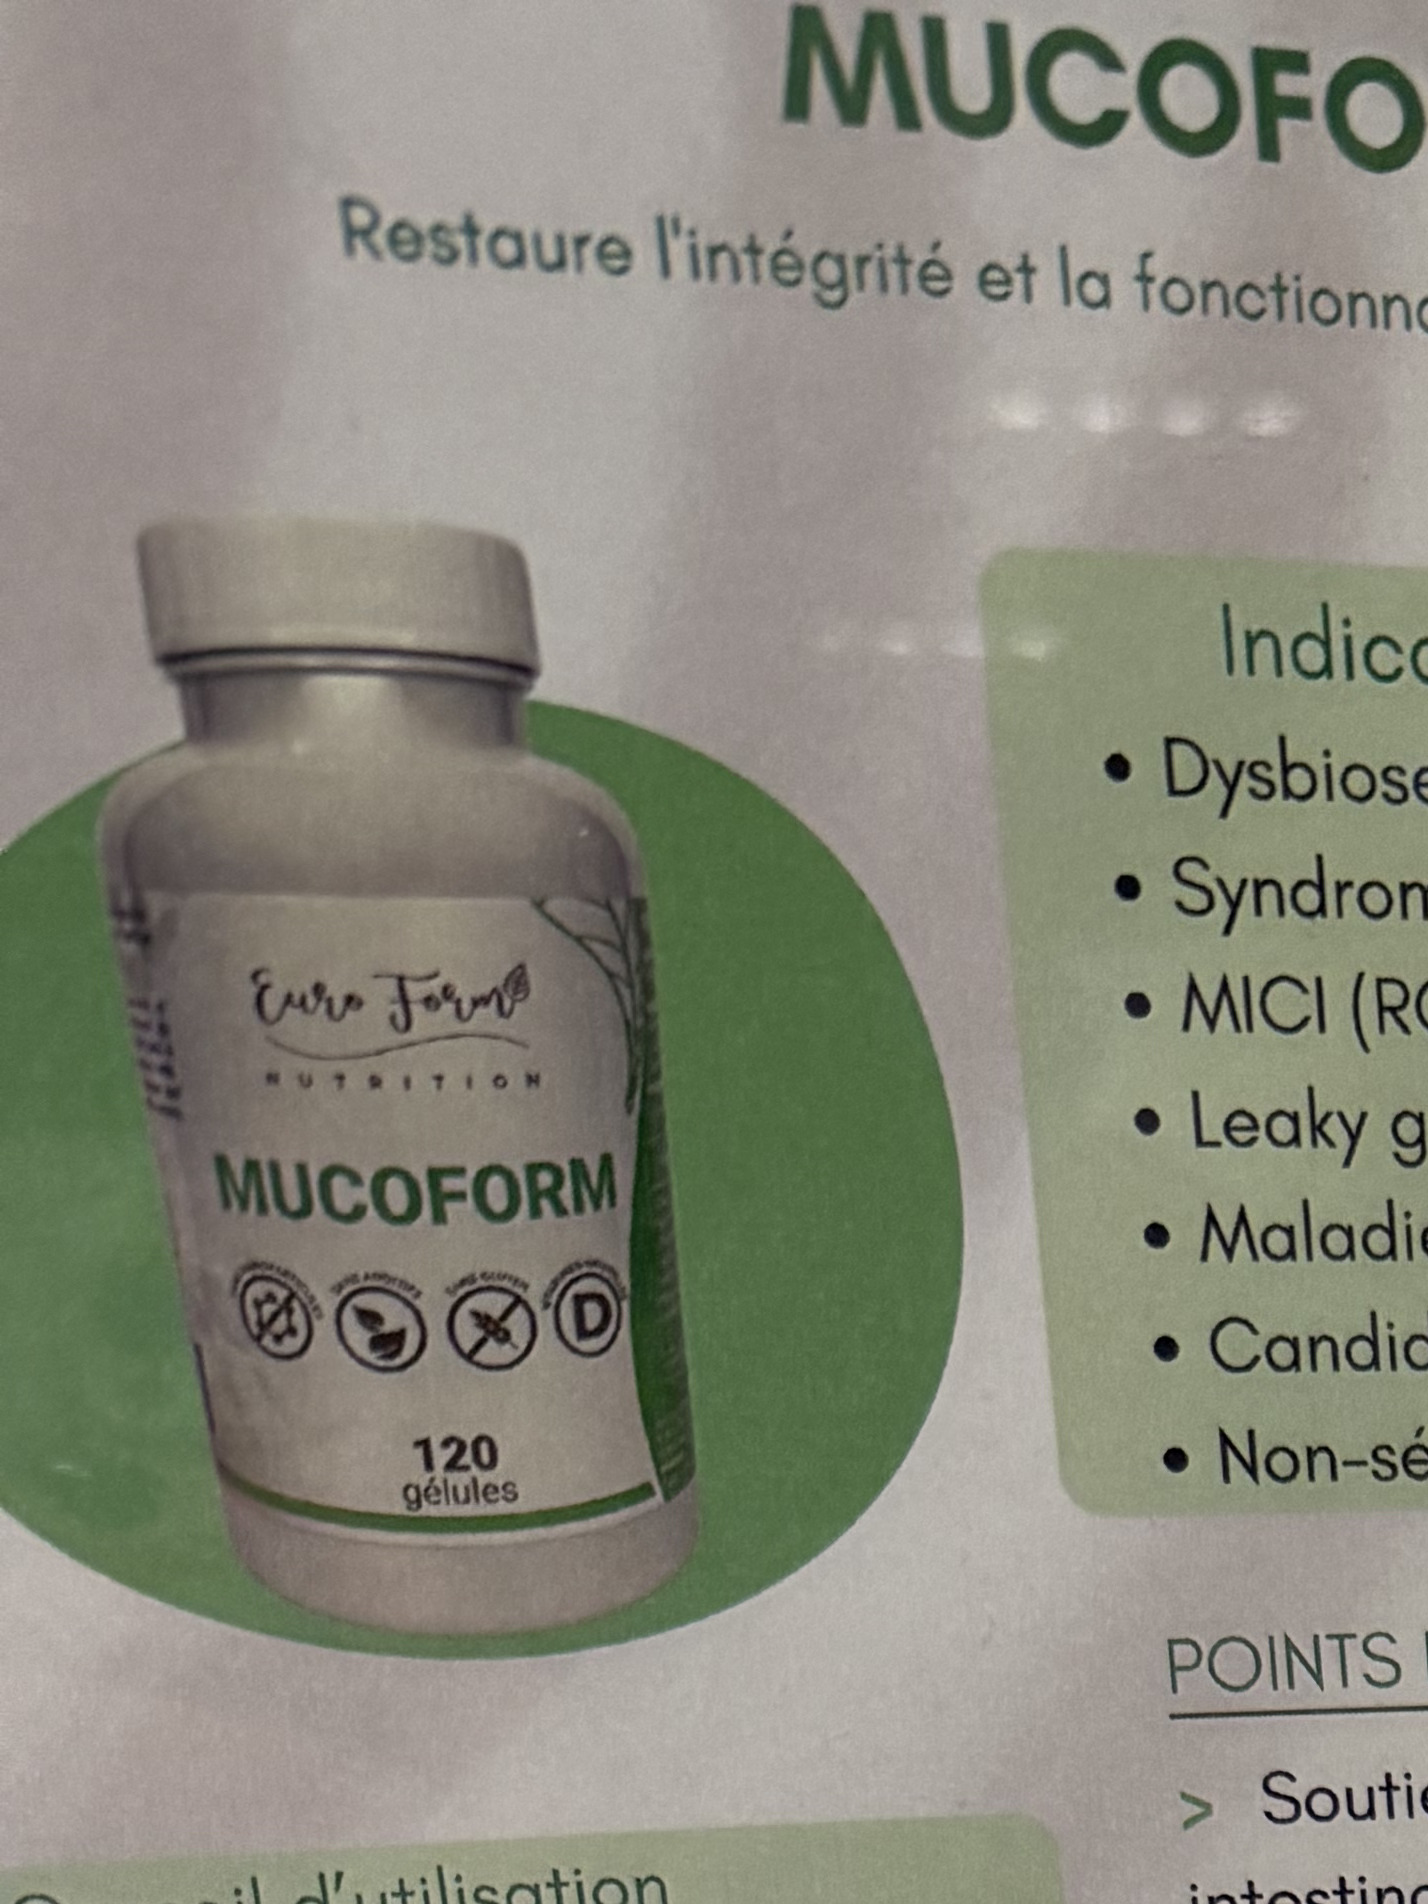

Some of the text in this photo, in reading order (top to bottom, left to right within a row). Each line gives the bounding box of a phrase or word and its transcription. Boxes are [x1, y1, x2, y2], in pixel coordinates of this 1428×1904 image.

[337, 193, 633, 277] Restaure
[654, 212, 954, 311] l'intégrité
[977, 253, 1037, 304] et
[1059, 244, 1112, 310] la
[1182, 972, 1326, 1034] MICI
[1191, 1085, 1368, 1168] Leaky
[213, 1152, 617, 1226] MUCOFORM
[413, 1434, 498, 1473] 120
[402, 1476, 518, 1512] gélules
[1167, 1631, 1401, 1694] POINTS
